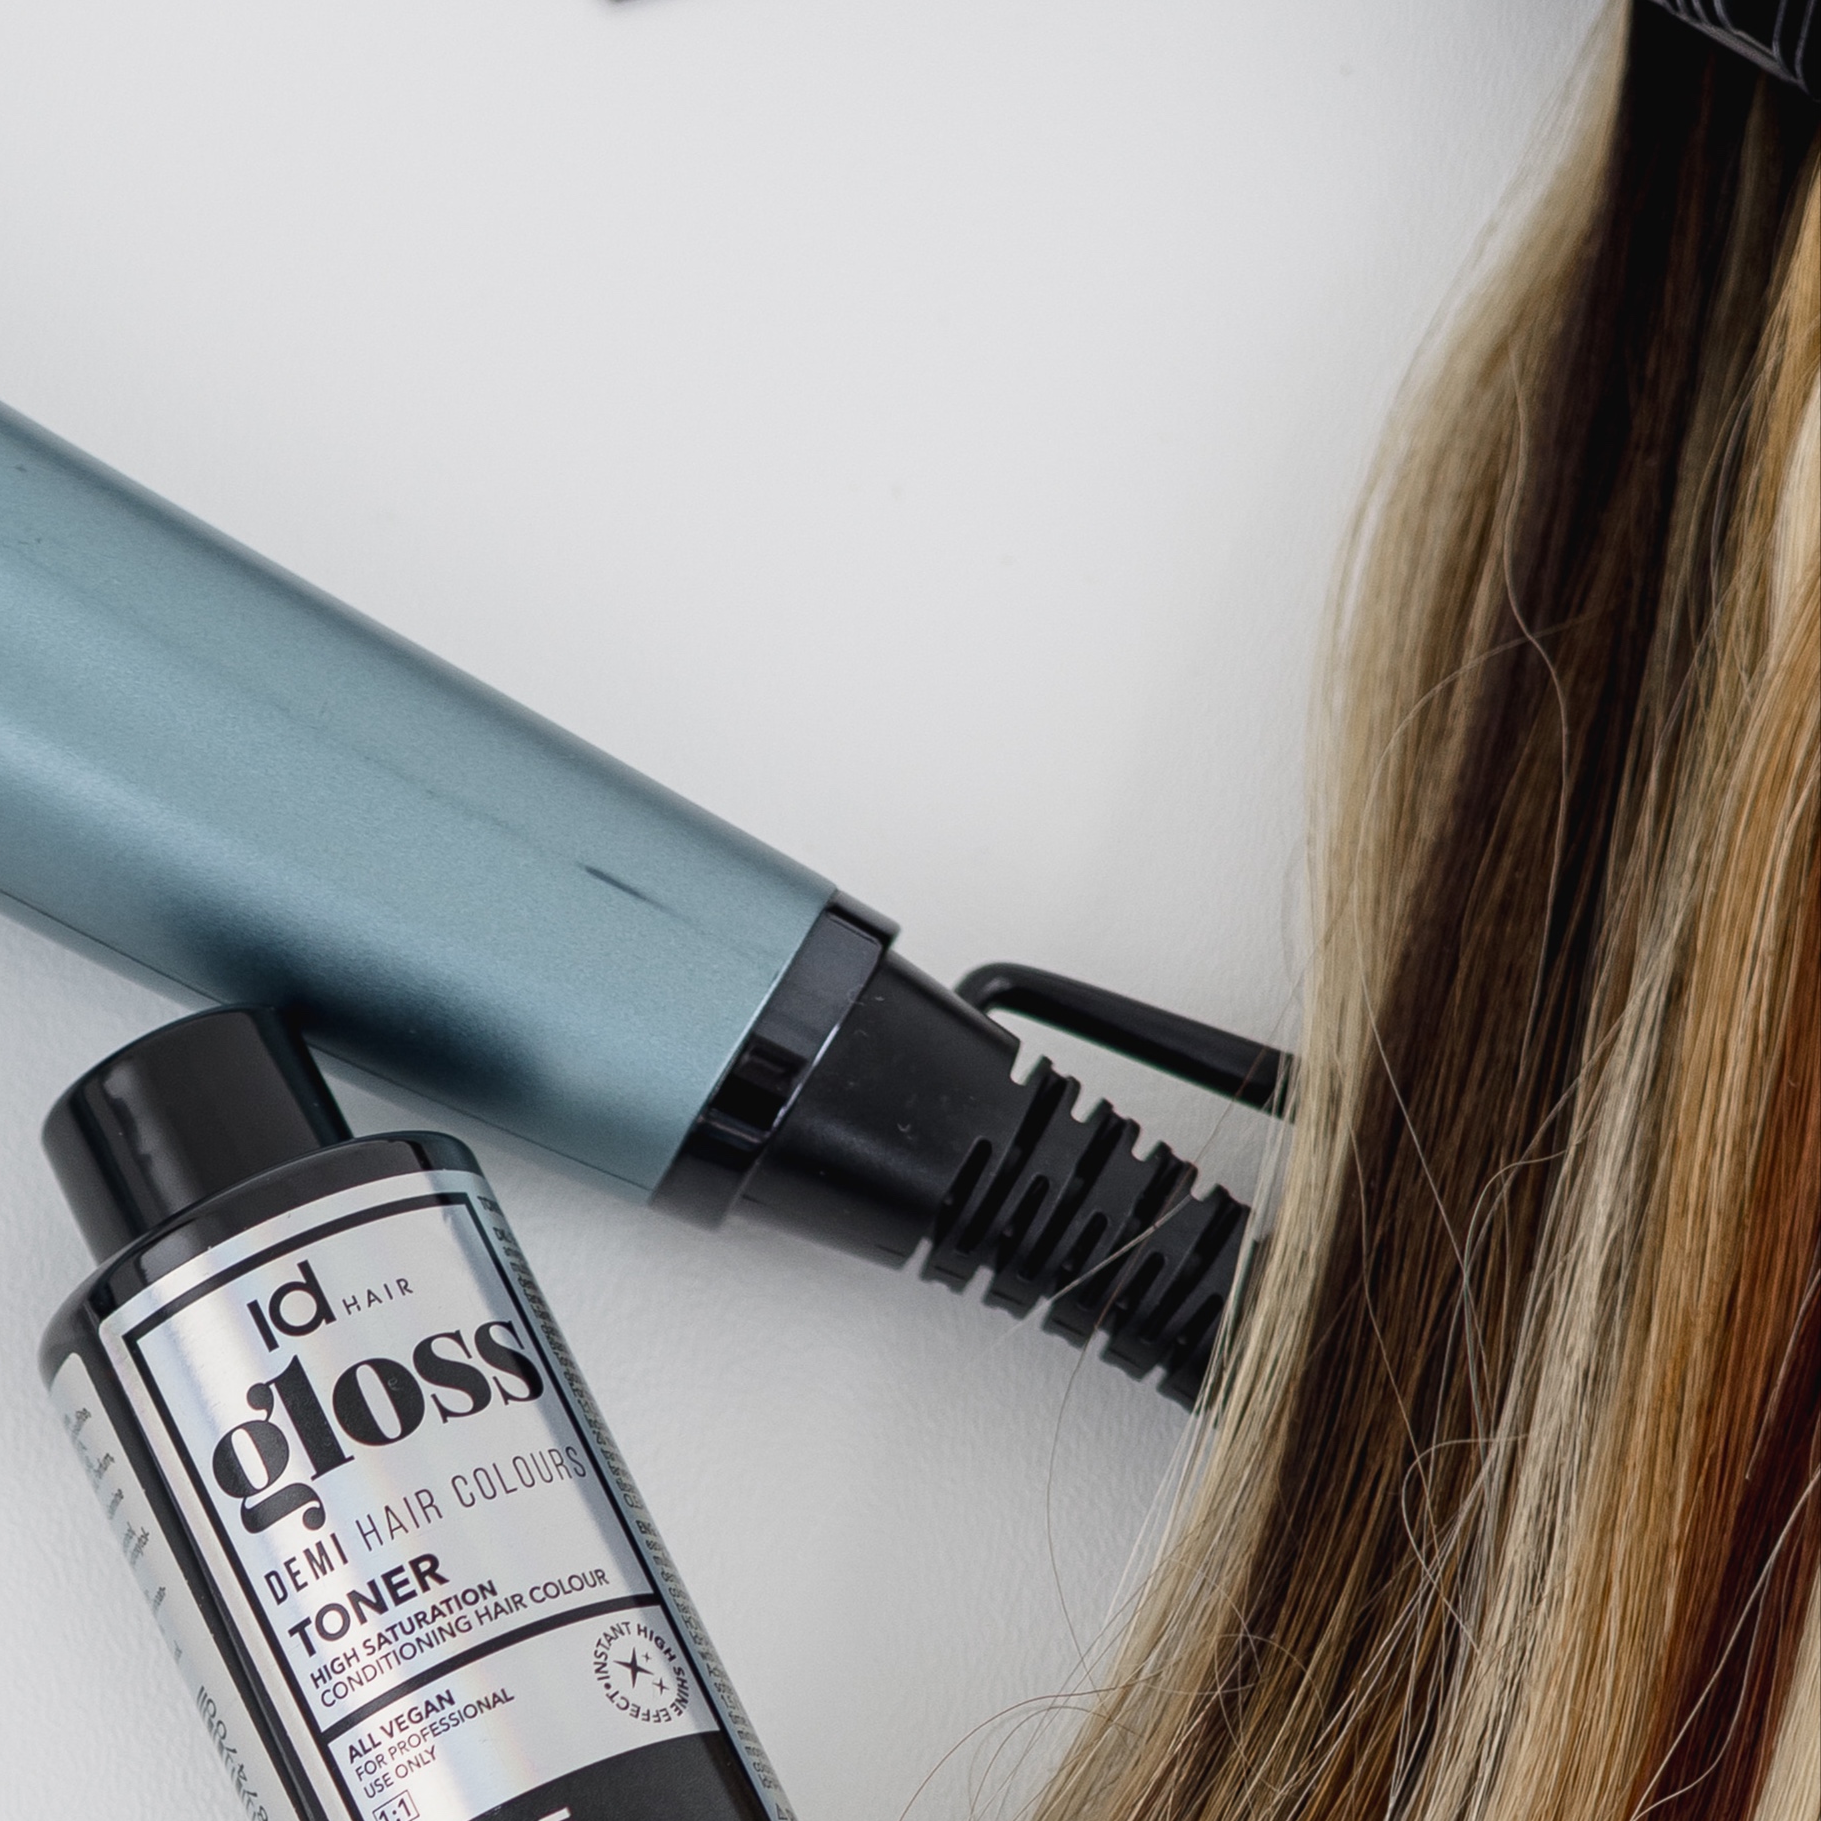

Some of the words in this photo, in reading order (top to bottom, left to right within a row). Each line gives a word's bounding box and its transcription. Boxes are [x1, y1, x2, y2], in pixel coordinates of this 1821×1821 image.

[342, 1278, 414, 1316] HAIR
[212, 1319, 545, 1534] gloss
[263, 1532, 349, 1606] DEMI
[355, 1488, 443, 1552] HAIR
[451, 1445, 589, 1509] COLOURS
[287, 1553, 450, 1658] TONER
[309, 1647, 360, 1690] HIGH
[362, 1579, 498, 1656] SATURATION
[320, 1614, 473, 1708] CONDITIONING
[474, 1593, 528, 1626] HAIR
[528, 1568, 610, 1604] COLOUR
[637, 1623, 677, 1663] HIGH
[593, 1621, 631, 1681] INSTANT
[348, 1733, 382, 1765] ALL
[379, 1690, 456, 1739] VEGAN
[605, 1690, 672, 1723] EFFECT
[670, 1666, 690, 1716] SHINE
[354, 1753, 387, 1782] FOR
[388, 1688, 515, 1757] PROFESSIONAL
[363, 1772, 394, 1799] USE
[394, 1744, 436, 1779] ONLY
